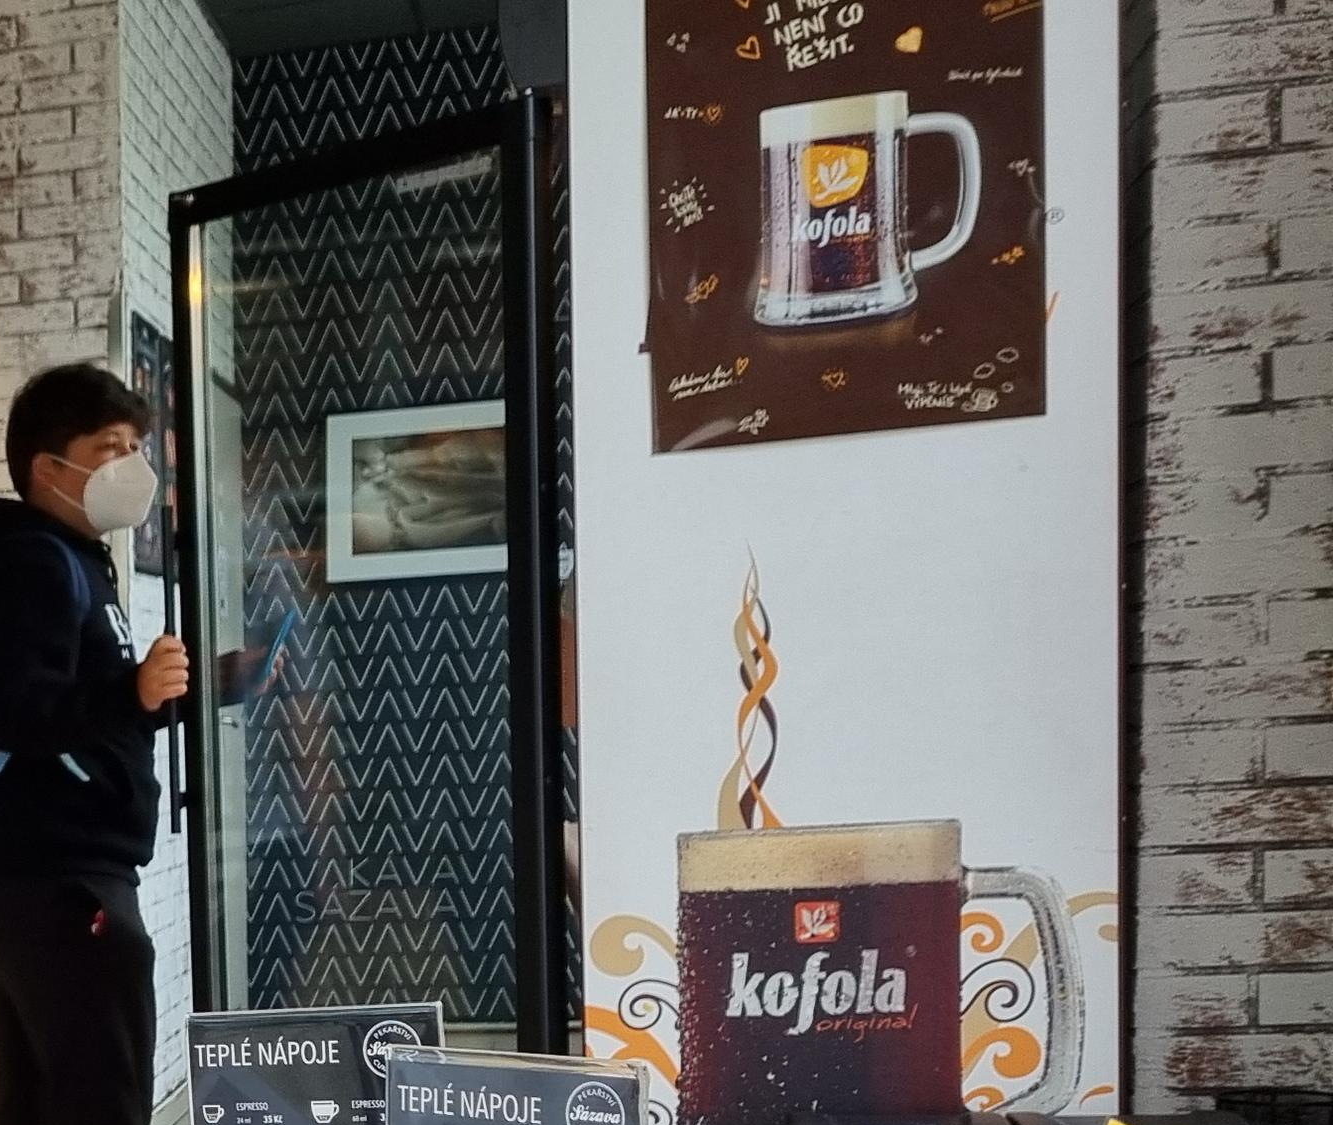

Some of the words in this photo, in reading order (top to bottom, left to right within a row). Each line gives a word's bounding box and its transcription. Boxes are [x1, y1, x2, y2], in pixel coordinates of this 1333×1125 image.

[773, 6, 829, 46] NENÍ
[836, 2, 864, 28] CO
[791, 205, 872, 249] kofola
[294, 882, 460, 924] SÁZAVA
[726, 948, 908, 1036] kofola
[814, 1003, 919, 1044] original
[193, 1037, 253, 1068] TEPLÉ
[258, 1036, 341, 1067] NÁPOJE
[236, 1101, 269, 1112] ESPRESSO
[351, 1100, 386, 1110] ESPRESSO
[397, 1082, 455, 1116] TEPLÉ
[460, 1086, 542, 1125] NÁPOJE
[570, 1104, 621, 1124] Sázava
